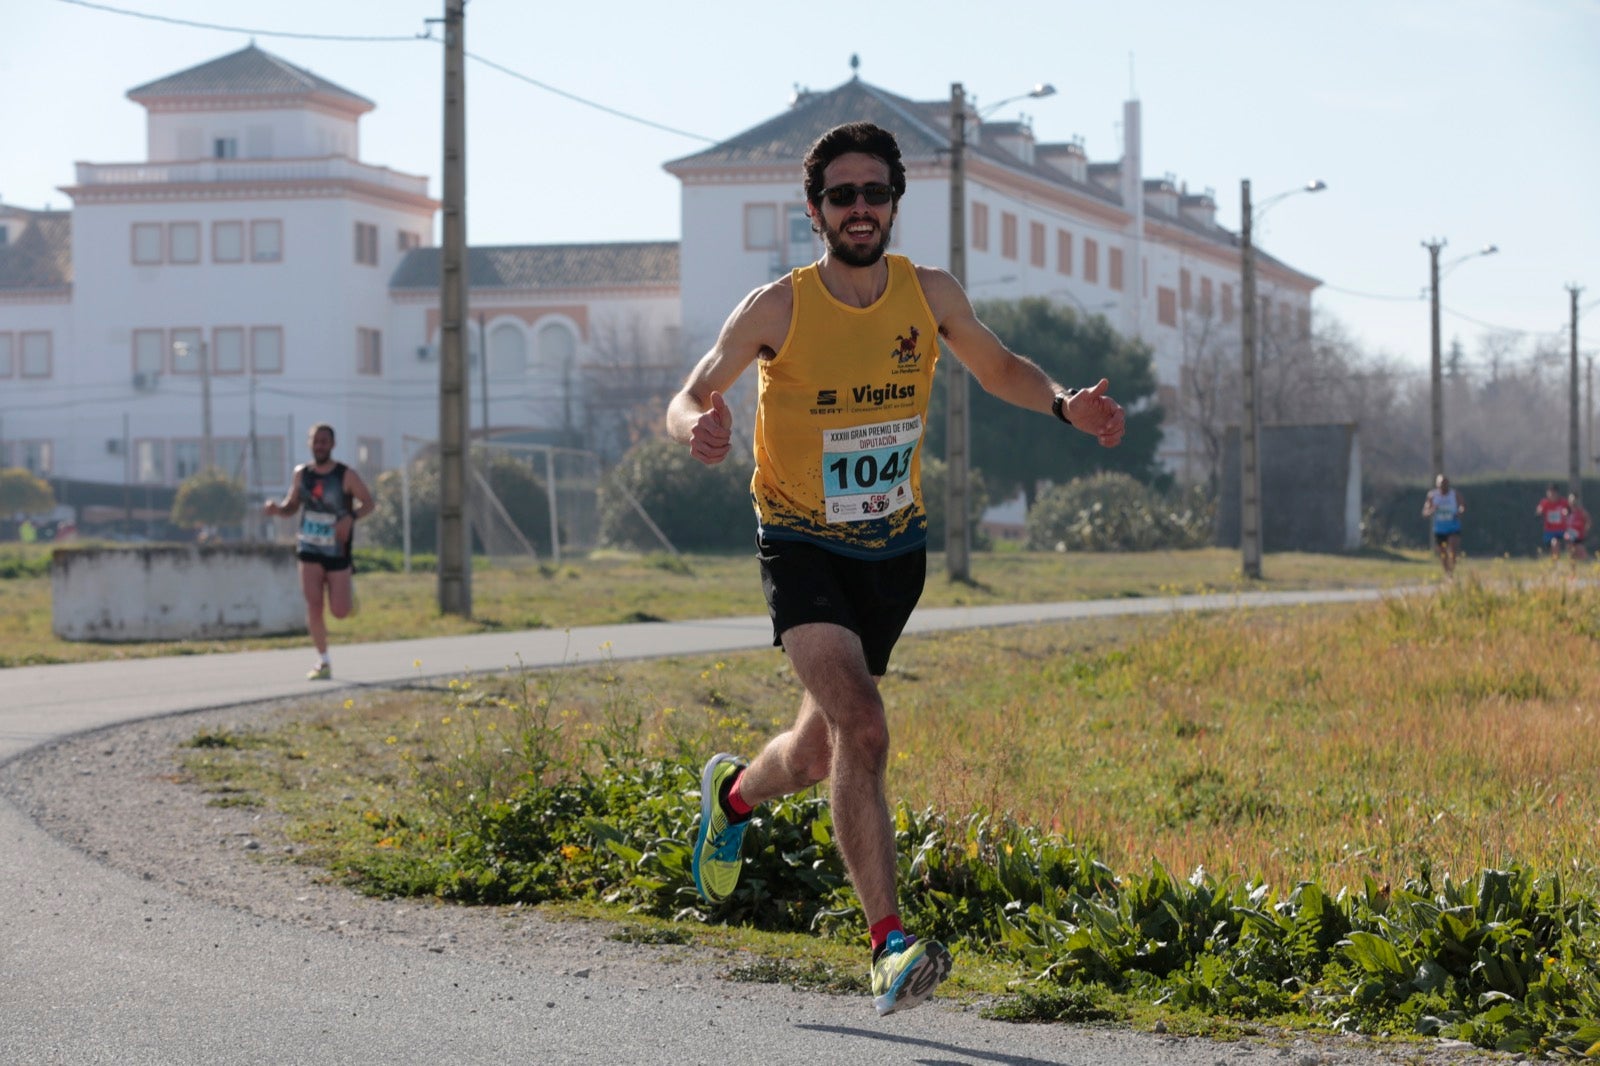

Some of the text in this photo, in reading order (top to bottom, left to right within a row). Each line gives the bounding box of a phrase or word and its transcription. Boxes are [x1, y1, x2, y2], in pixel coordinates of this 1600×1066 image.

[852, 382, 915, 405] Vigilsa
[830, 431, 849, 442] XXXIII
[850, 429, 867, 440] GRAN
[868, 425, 891, 437] PREMIO
[893, 423, 901, 433] DE
[859, 434, 897, 449] DIPUTACIÓN
[830, 446, 913, 490] 1043
